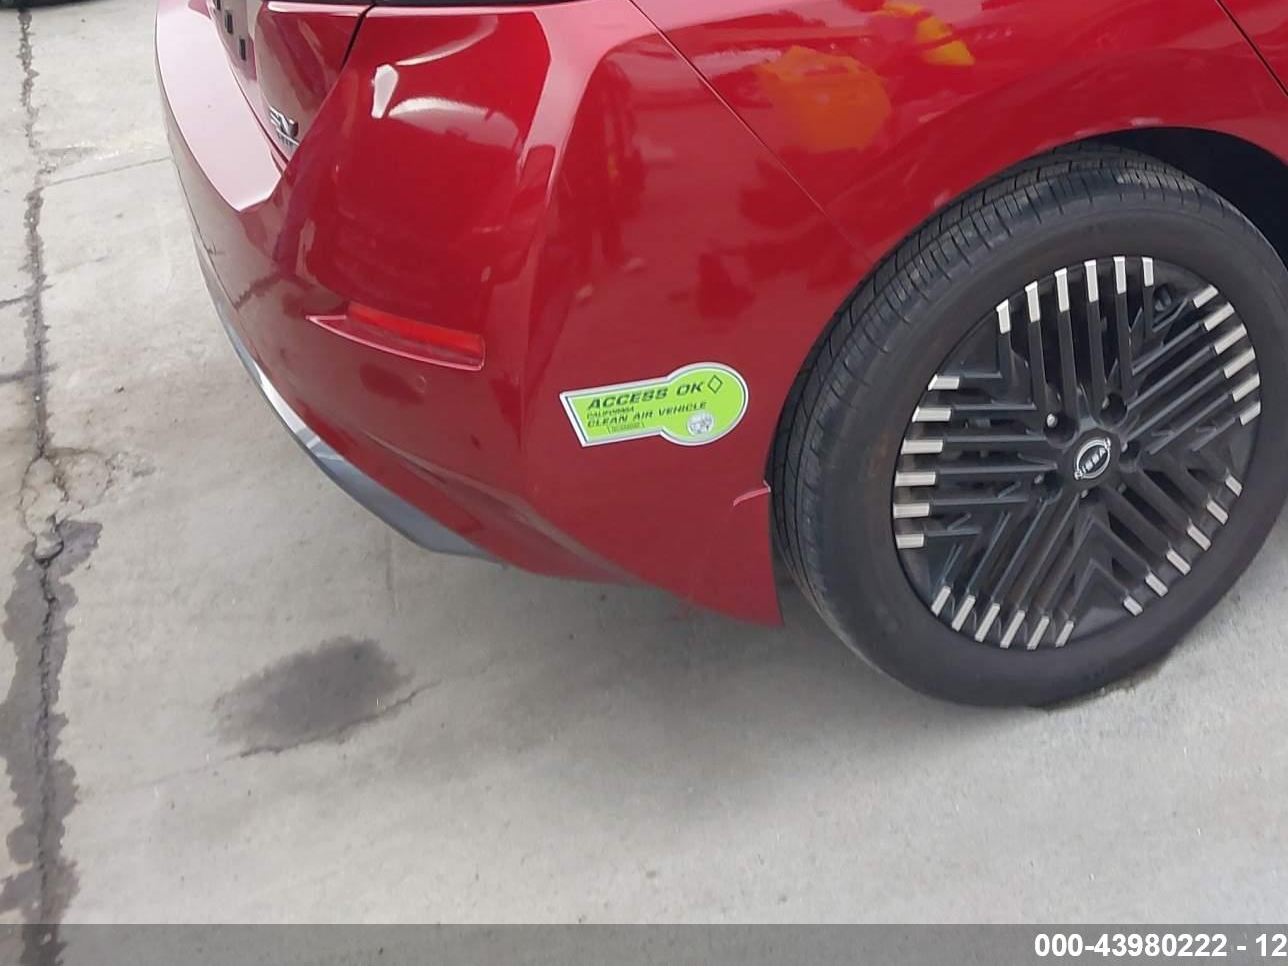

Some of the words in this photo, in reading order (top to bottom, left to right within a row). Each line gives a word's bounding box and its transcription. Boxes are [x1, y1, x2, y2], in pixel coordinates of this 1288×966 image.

[588, 387, 668, 410] ACCESS
[676, 381, 704, 395] OK
[587, 414, 628, 427] CLEAN
[633, 410, 653, 422] AIR
[658, 401, 707, 416] VEHICLE
